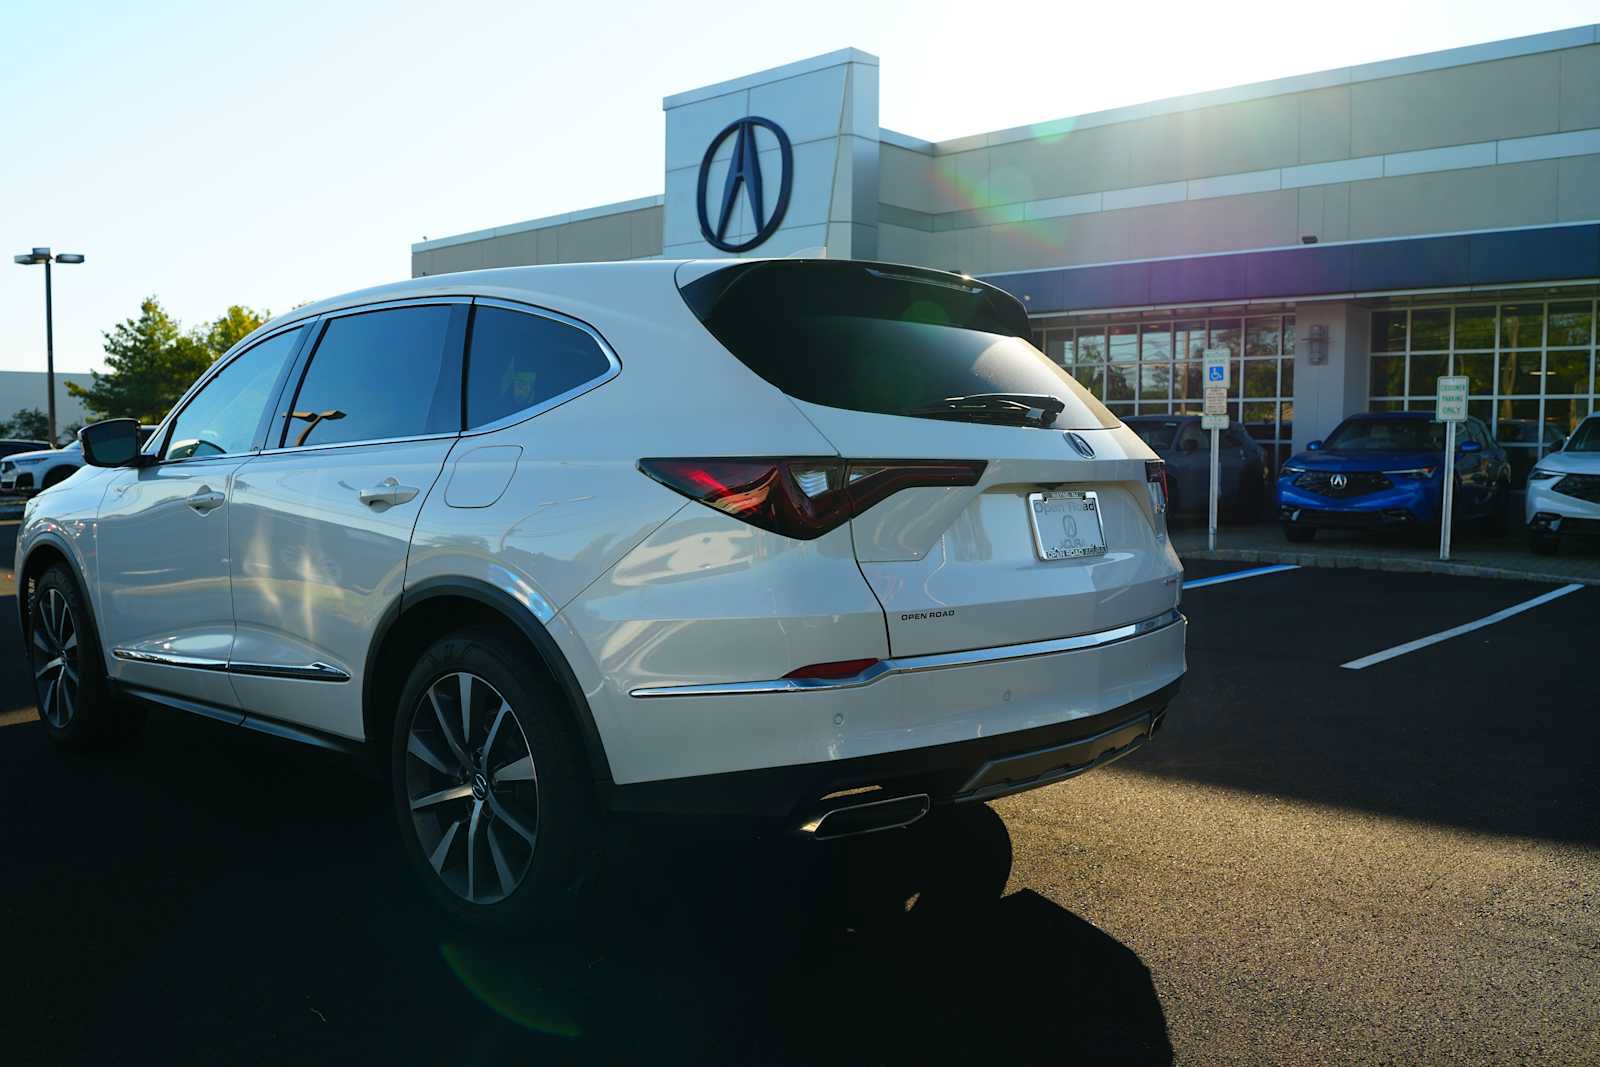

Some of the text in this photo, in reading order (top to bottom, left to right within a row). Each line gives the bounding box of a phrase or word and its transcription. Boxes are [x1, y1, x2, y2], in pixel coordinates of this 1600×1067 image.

[1442, 407, 1462, 415] ONLY
[901, 610, 955, 621] OPEN ROAD
